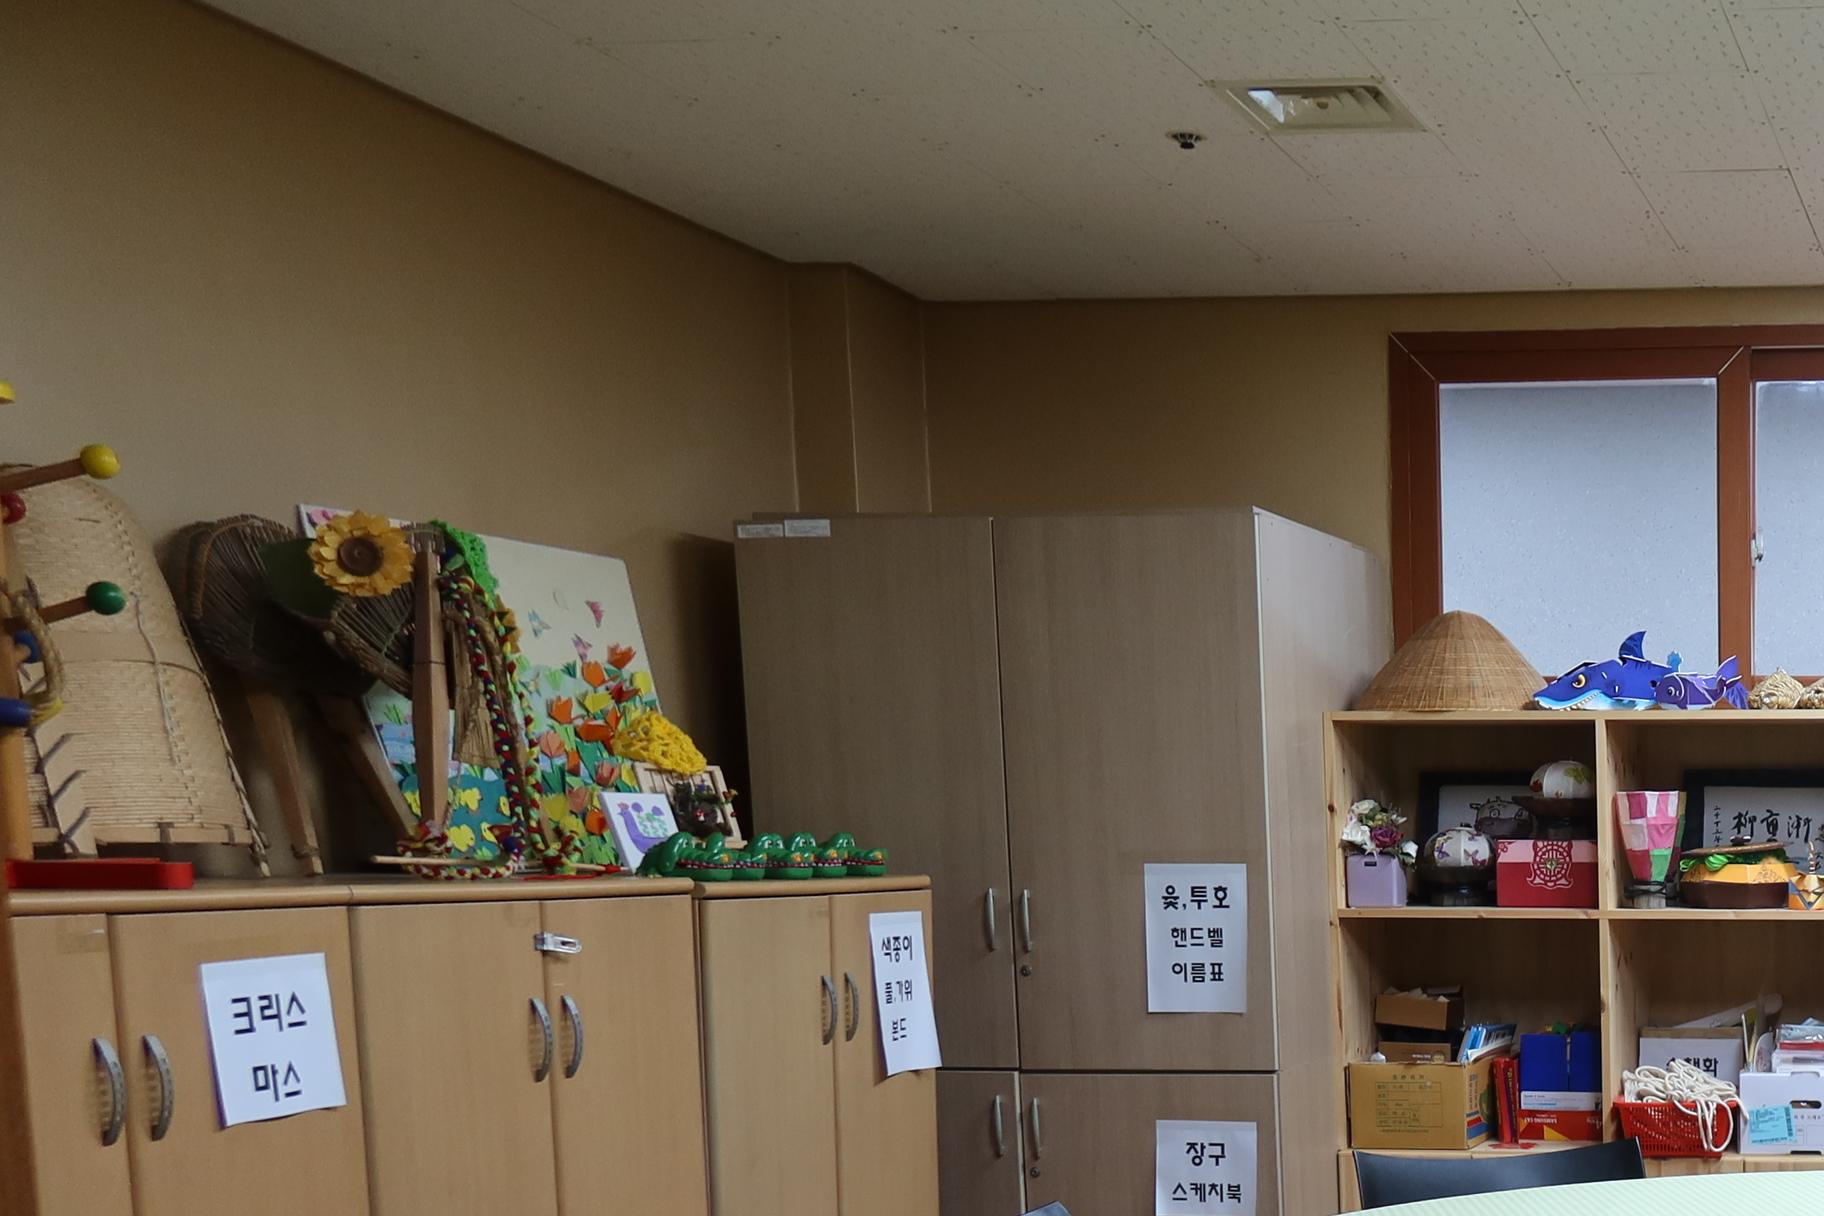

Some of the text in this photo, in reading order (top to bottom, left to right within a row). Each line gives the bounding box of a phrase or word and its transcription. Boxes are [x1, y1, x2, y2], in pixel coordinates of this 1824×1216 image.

[1161, 885, 1230, 910] 윷,투호
[881, 935, 913, 962] 색종이
[1170, 927, 1224, 948] 핸드벨
[1171, 962, 1224, 983] 이름표
[231, 991, 307, 1035] 크리스
[252, 1060, 302, 1102] 마스
[1186, 1142, 1226, 1166] 장구
[1172, 1182, 1242, 1203] 스케치북
